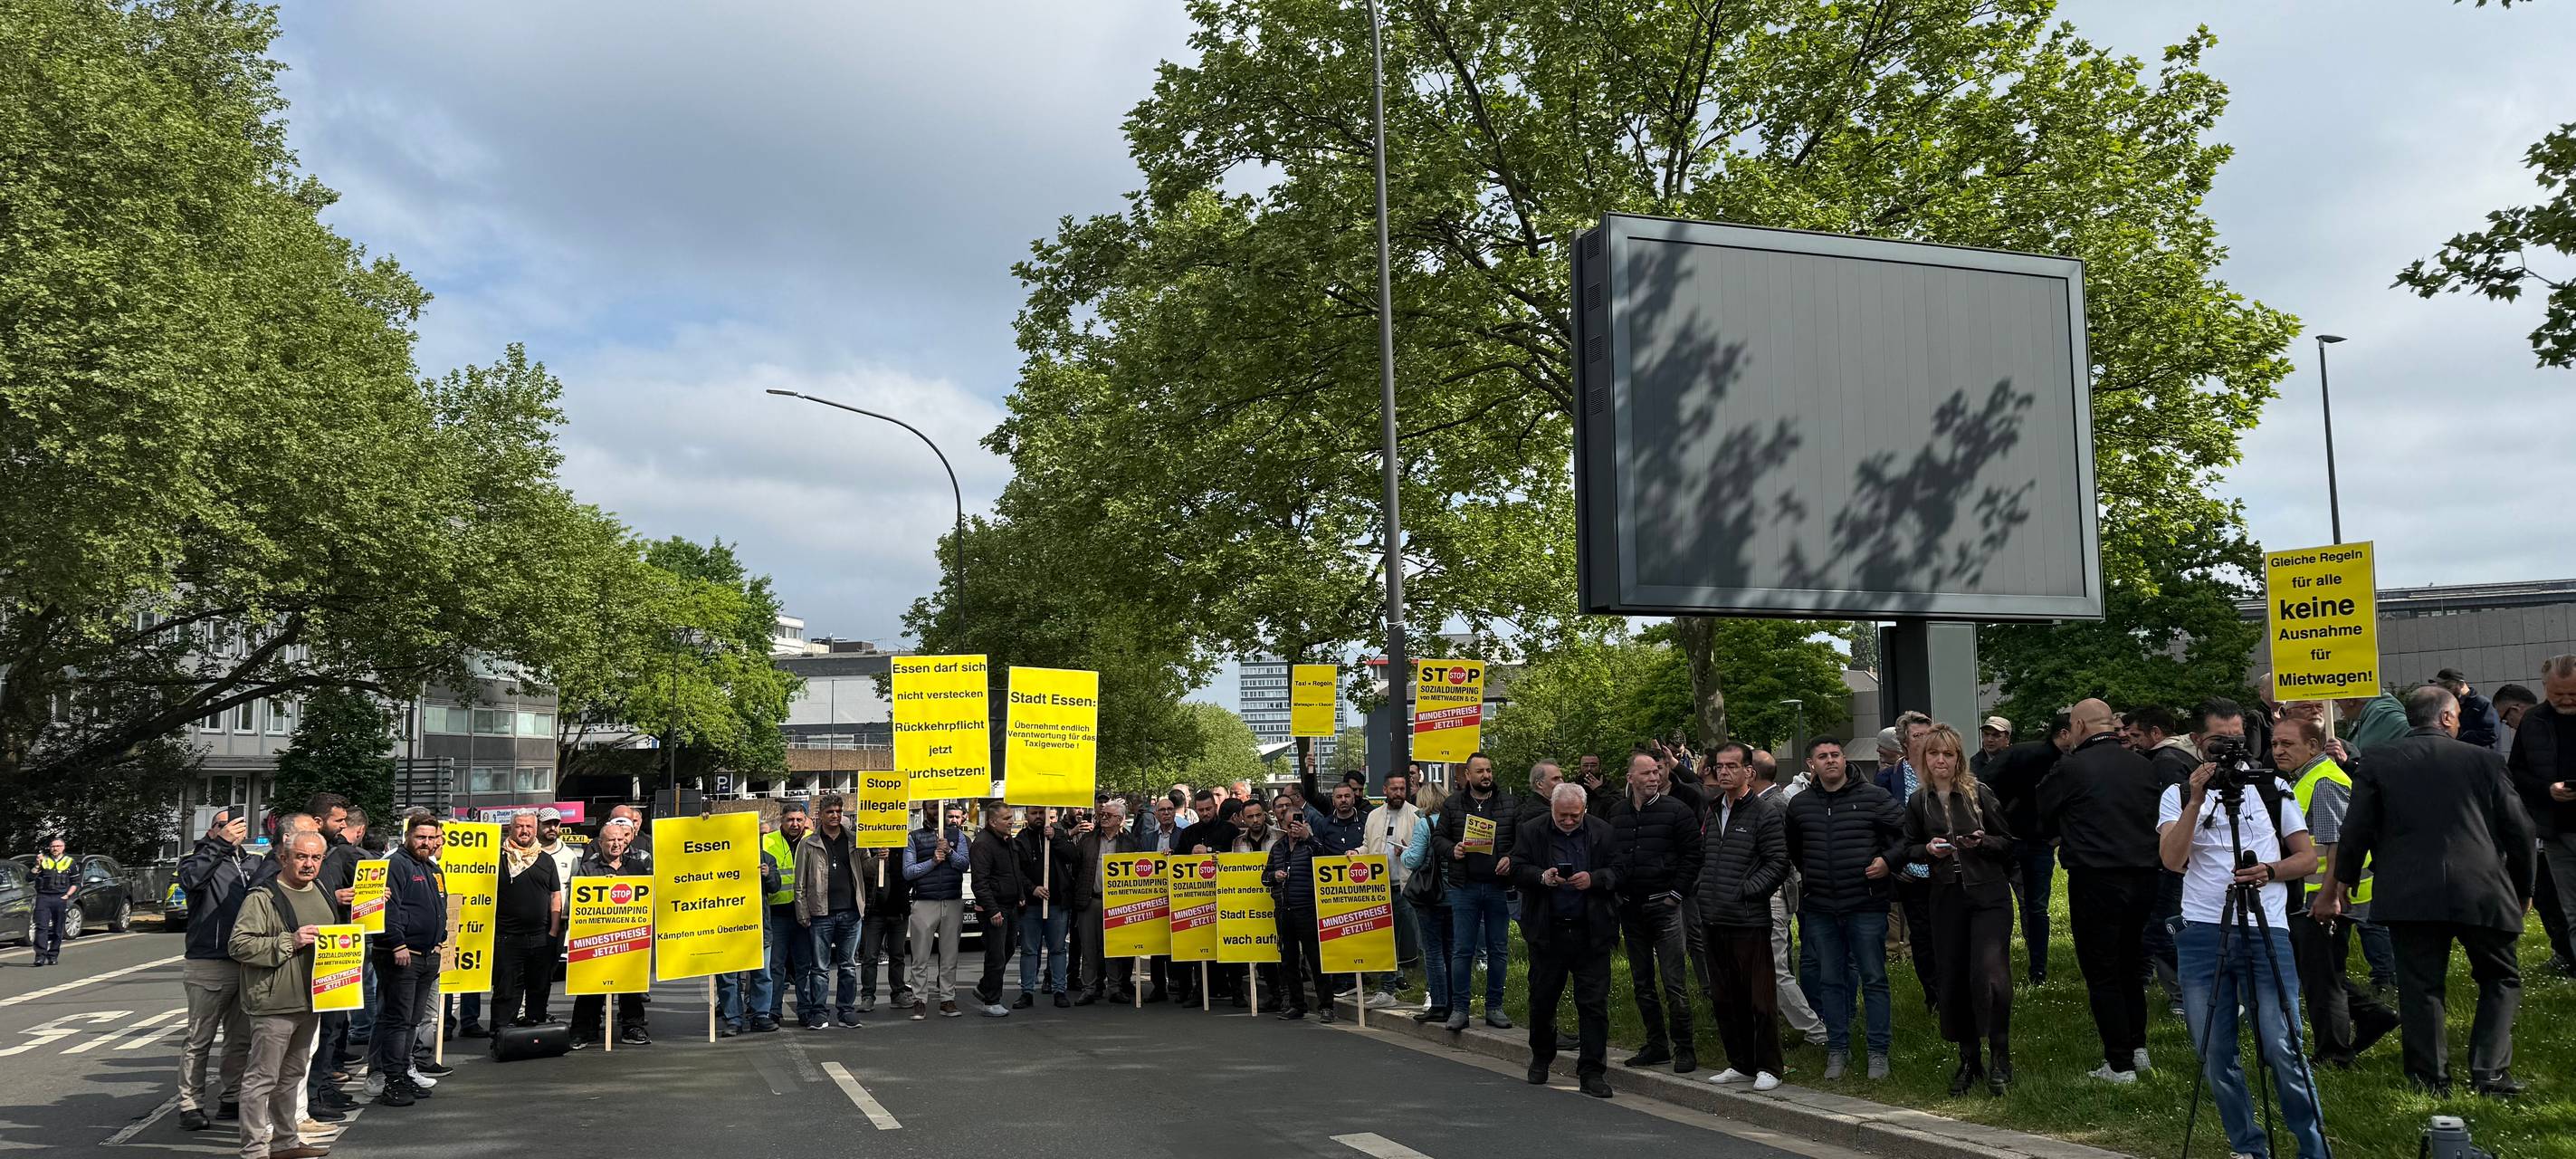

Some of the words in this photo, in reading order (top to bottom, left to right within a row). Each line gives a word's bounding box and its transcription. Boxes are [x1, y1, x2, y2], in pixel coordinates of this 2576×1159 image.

[2271, 555, 2316, 567] Gleiche
[2320, 550, 2362, 563] Regeln
[2292, 577, 2312, 589] für
[2316, 574, 2342, 587] alle
[2280, 596, 2354, 620] keine
[2279, 625, 2362, 640] Ausnahme
[2311, 648, 2332, 660] für
[892, 664, 930, 674] Essen
[934, 662, 958, 673] darf
[961, 662, 987, 672] sich
[1422, 666, 1480, 685] STOP
[2279, 670, 2372, 686] Mietwagen!
[897, 691, 924, 700] nicht
[926, 689, 983, 700] verstecken
[1420, 685, 1479, 694] SOZIALDUMPING
[1010, 692, 1046, 704] Stadt
[1051, 694, 1096, 707] Essen:
[1418, 706, 1478, 721] MINDESTPREISE
[895, 720, 985, 733] Rückkehrpflicht
[1015, 720, 1059, 731] Übernehmt
[1061, 724, 1090, 733] endlich
[1007, 730, 1066, 741] Verantwortung
[1069, 733, 1080, 741] für
[1082, 733, 1096, 742] das
[929, 745, 953, 757] jetzt
[1024, 740, 1075, 750] Taxigewerbe
[908, 766, 985, 779] urchsetzen!
[717, 776, 728, 791] P
[866, 778, 902, 790] Stopp
[860, 800, 907, 813] illegale
[857, 823, 907, 831] Strukturen
[442, 830, 488, 847] ssen
[683, 840, 730, 854] Essen
[445, 861, 496, 875] handeln
[1107, 858, 1168, 877] STOP
[1172, 860, 1216, 879] STO
[1199, 866, 1216, 874] STOP
[1318, 862, 1385, 884] STOP
[1350, 869, 1368, 877] STOP
[357, 867, 386, 882] STOP
[673, 870, 714, 884] schaut
[716, 869, 740, 880] weg
[1107, 878, 1168, 888] SOZIALDUMPING
[577, 884, 650, 904] STOP
[611, 889, 631, 898] STOP
[1216, 886, 1236, 895] sieht
[1320, 884, 1386, 896] SOZIALDUMPING
[470, 894, 491, 905] alle
[671, 896, 746, 913] Taxifahrer
[1332, 896, 1370, 904] MIETWAGEN
[575, 906, 648, 915] SOZIALDUMPING
[1107, 896, 1168, 917] MINDESTPREISE
[1174, 904, 1216, 920] MINDESTPR
[588, 916, 630, 924] MIETWAGEN
[1220, 910, 1245, 919] Stadt
[1322, 905, 1388, 928] MINDESTPREISE
[466, 921, 484, 933] für
[657, 930, 695, 941] Kämpfen
[697, 928, 715, 936] ums
[717, 924, 758, 934] Überleben
[318, 934, 361, 951] STOP
[573, 926, 647, 949] MINDESTPREISE
[1223, 934, 1252, 944] wach
[318, 951, 362, 959] SOZIALDUMPING
